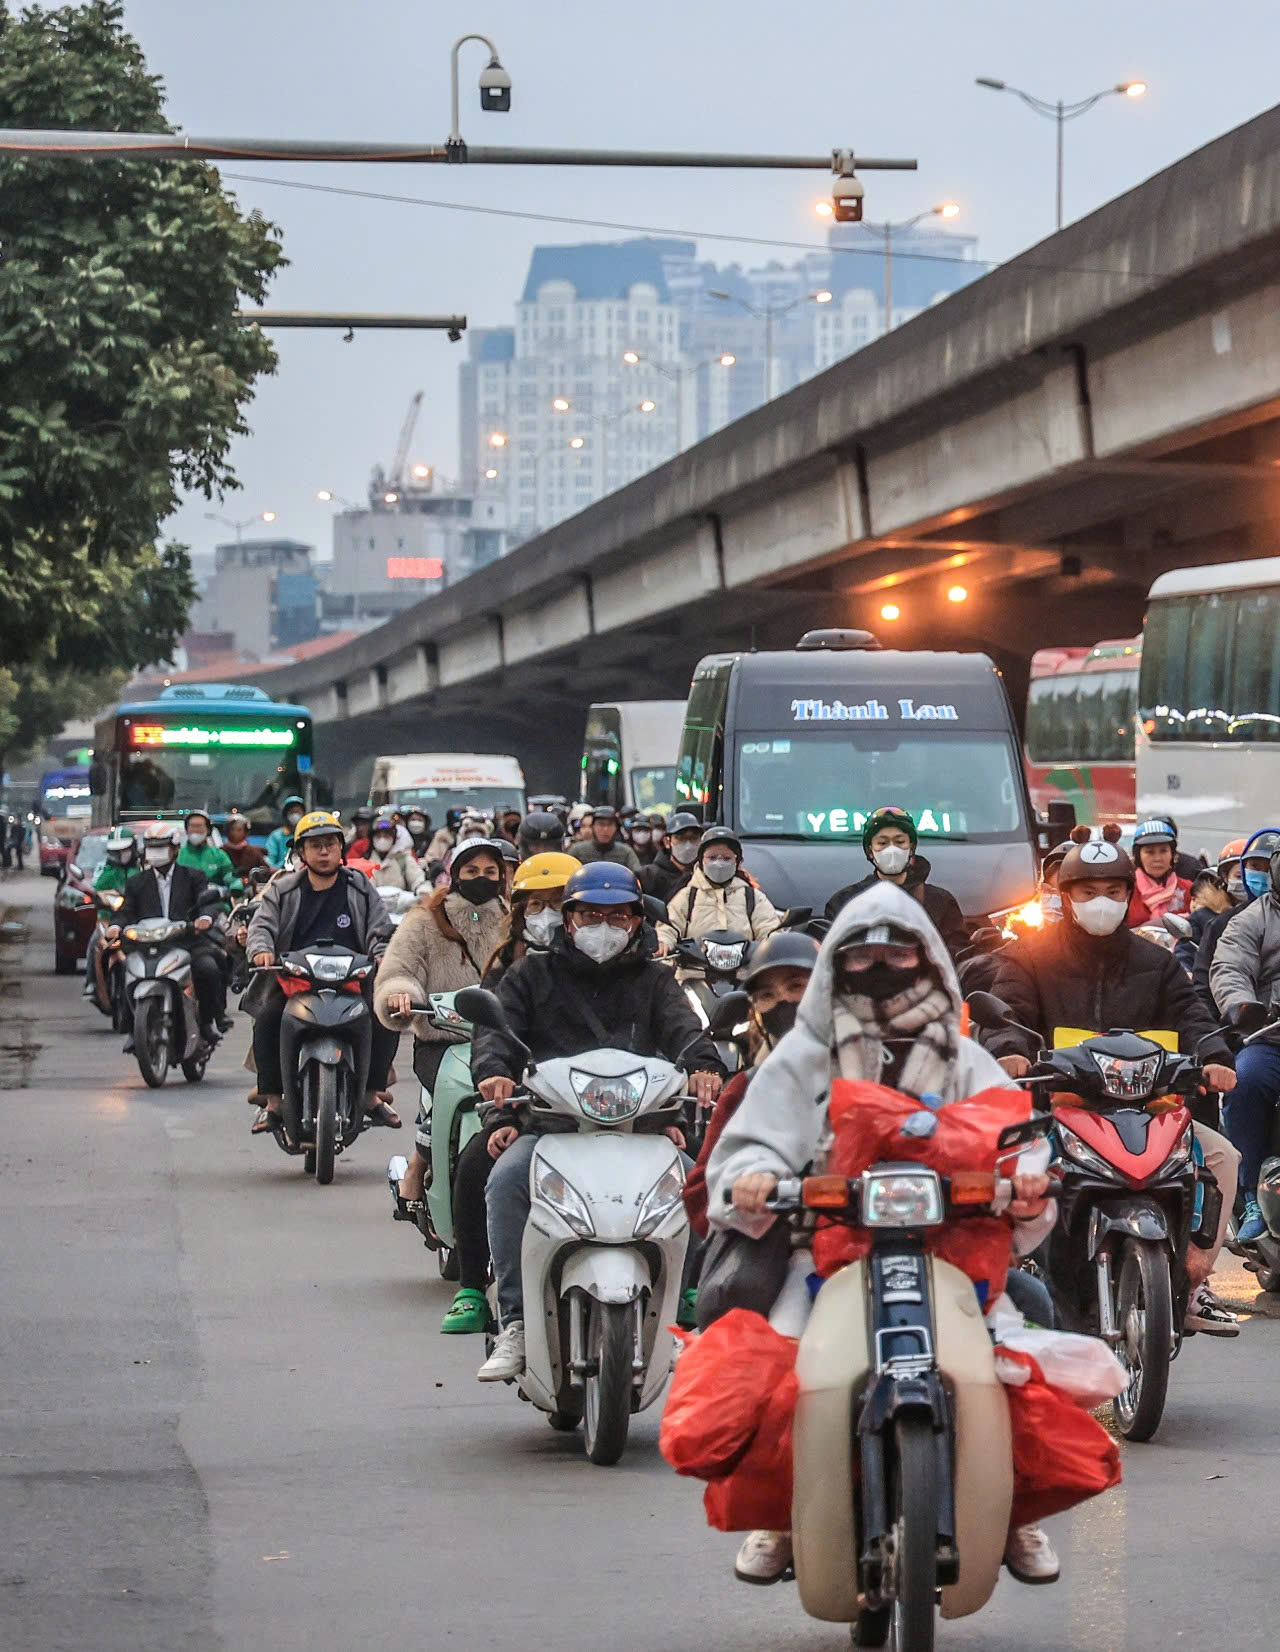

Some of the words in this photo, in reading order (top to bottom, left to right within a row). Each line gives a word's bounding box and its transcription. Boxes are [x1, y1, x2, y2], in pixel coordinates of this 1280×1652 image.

[791, 699, 889, 720] Thành
[898, 699, 959, 720] Lan
[917, 809, 951, 832] ÁI
